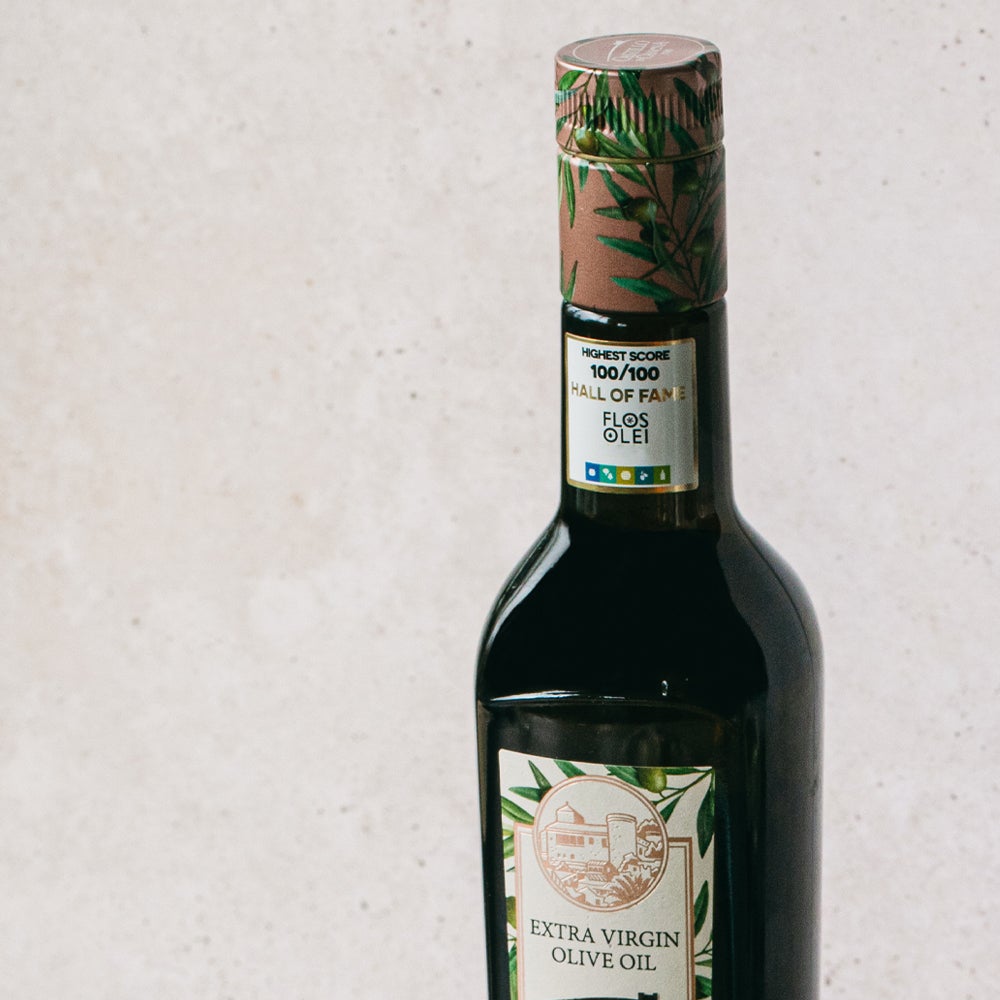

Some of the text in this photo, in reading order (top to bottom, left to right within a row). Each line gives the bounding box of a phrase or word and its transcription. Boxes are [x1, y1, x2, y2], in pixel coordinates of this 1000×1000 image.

[582, 347, 670, 361] HIGHEST SCORE
[590, 363, 660, 382] 100/100
[571, 381, 686, 403] HALL OF FAME
[603, 411, 649, 428] FLOS
[603, 427, 649, 444] OLEI
[530, 919, 680, 947] EXTRA VIRGIN
[552, 947, 657, 971] OLIVE OIL
